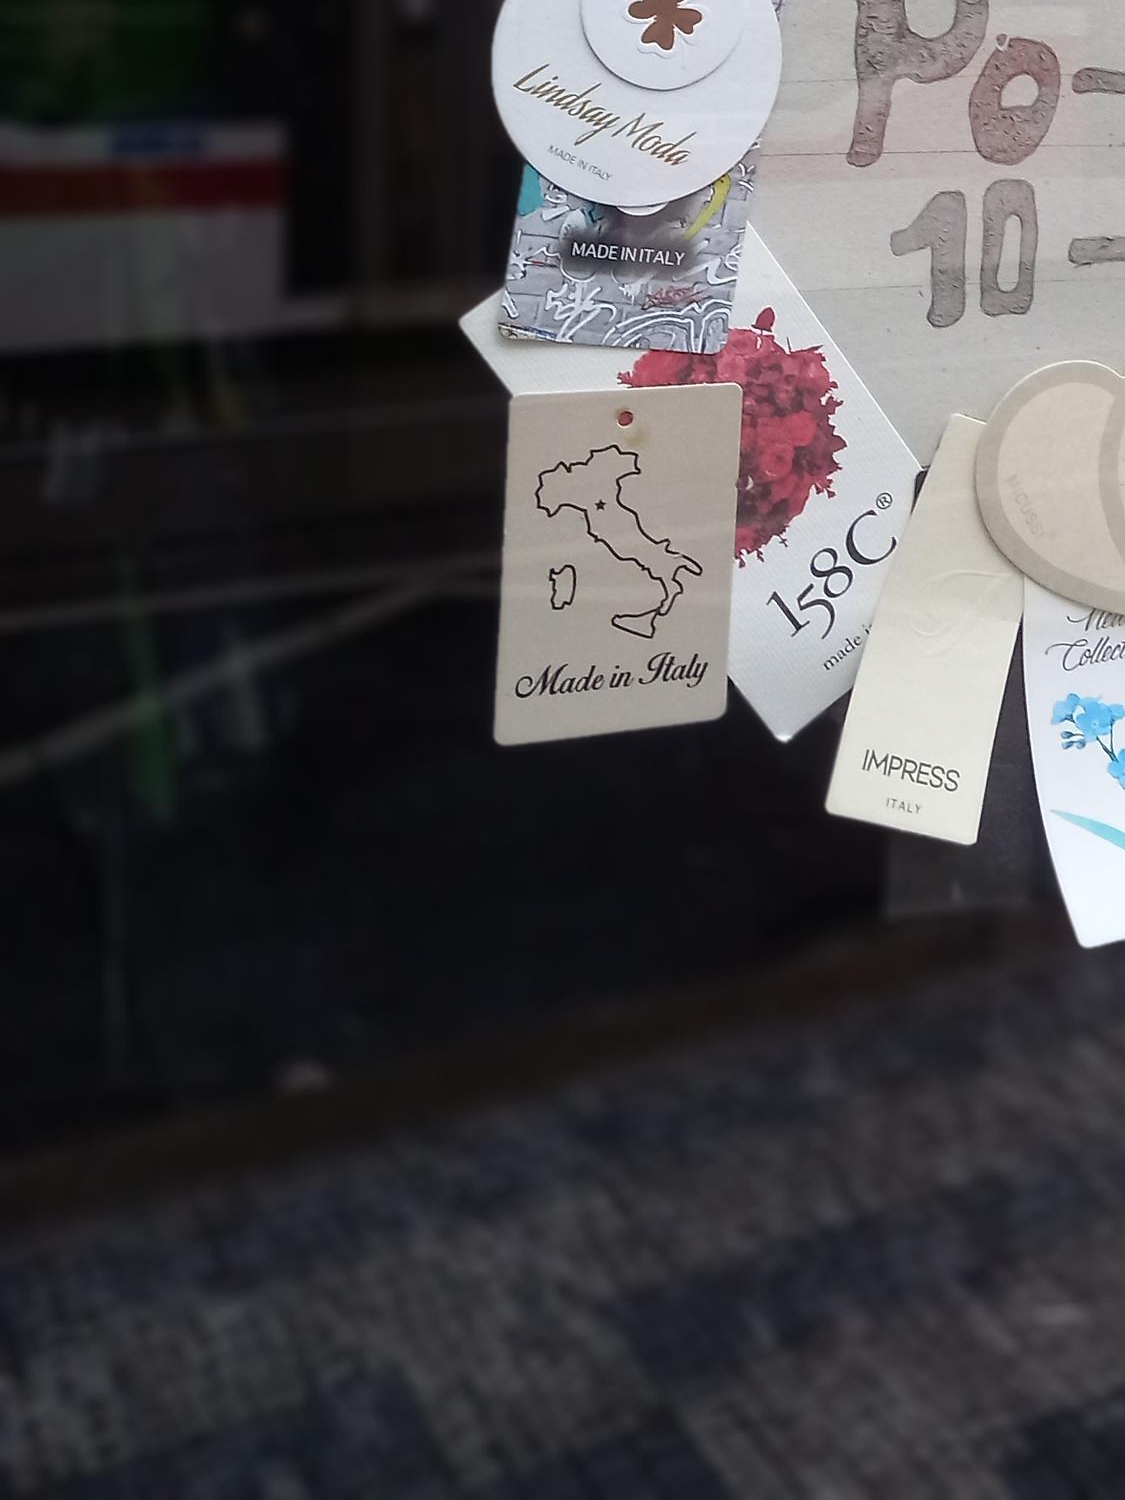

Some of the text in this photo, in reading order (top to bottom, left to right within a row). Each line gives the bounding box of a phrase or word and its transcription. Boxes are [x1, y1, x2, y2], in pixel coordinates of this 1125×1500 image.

[513, 63, 698, 167] Lindsay Moda
[547, 145, 614, 182] MADE IN ITALY
[571, 241, 686, 267] MADE IN ITALY
[823, 635, 863, 671] made
[515, 652, 709, 698] Made in Italy
[862, 749, 960, 792] IMPRESS
[886, 798, 921, 814] ITALY
